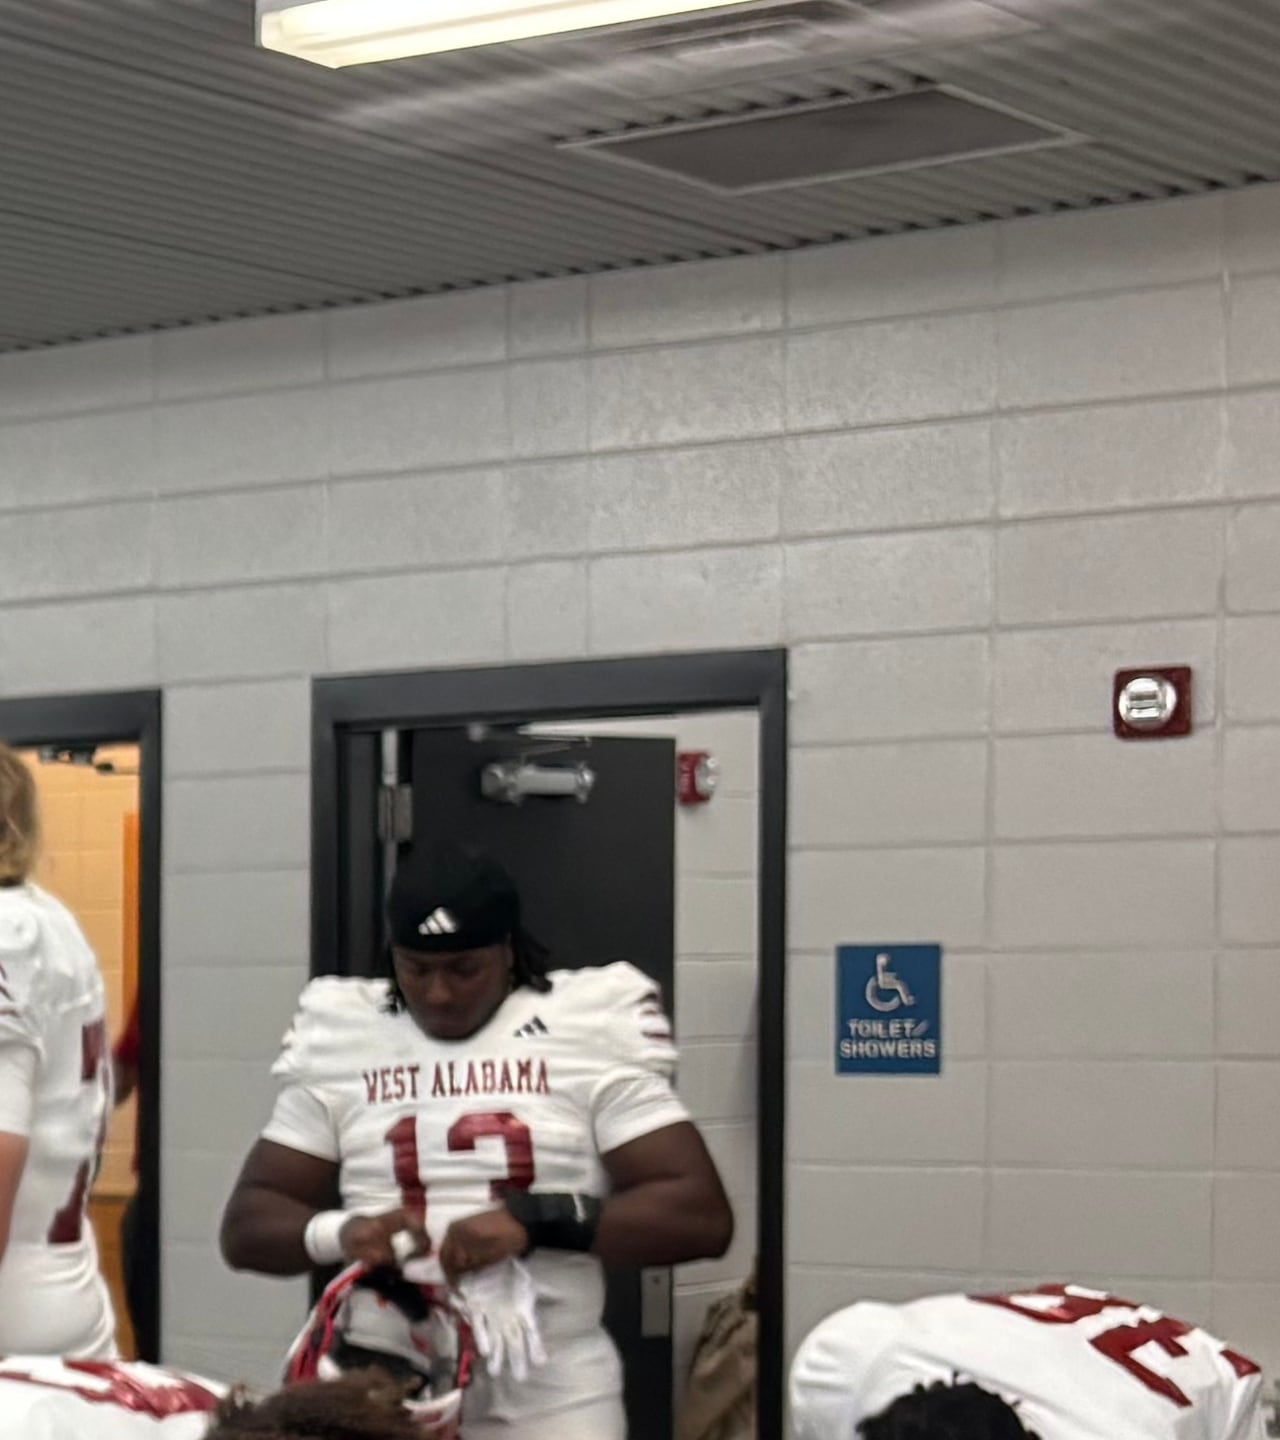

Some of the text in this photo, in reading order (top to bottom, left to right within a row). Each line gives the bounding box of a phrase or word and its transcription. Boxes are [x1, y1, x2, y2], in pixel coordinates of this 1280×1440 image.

[840, 1039, 937, 1059] SHOWERS
[362, 1058, 551, 1104] WEST ALABAMA
